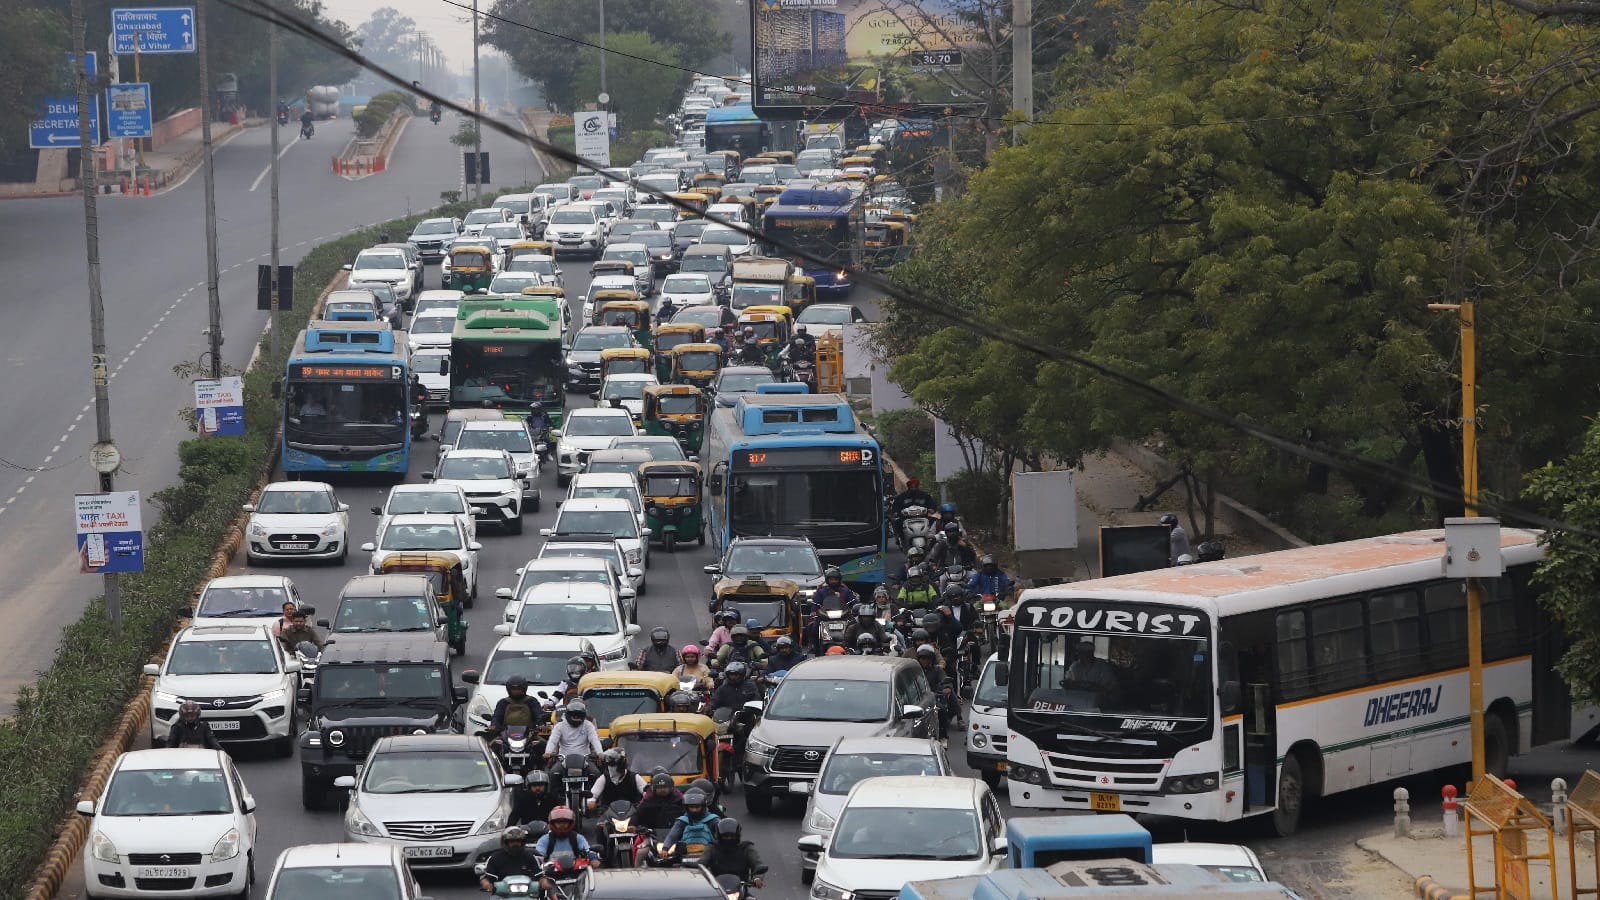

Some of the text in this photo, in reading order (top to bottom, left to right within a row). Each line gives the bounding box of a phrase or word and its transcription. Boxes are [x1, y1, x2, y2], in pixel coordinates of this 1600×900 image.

[48, 104, 79, 114] DELHI
[32, 119, 97, 129] SECRETART
[861, 449, 873, 461] D
[106, 511, 126, 520] TAXI
[1027, 606, 1201, 635] TOURIST
[1033, 700, 1066, 712] DELHI
[1364, 684, 1442, 727] DHEERAJ
